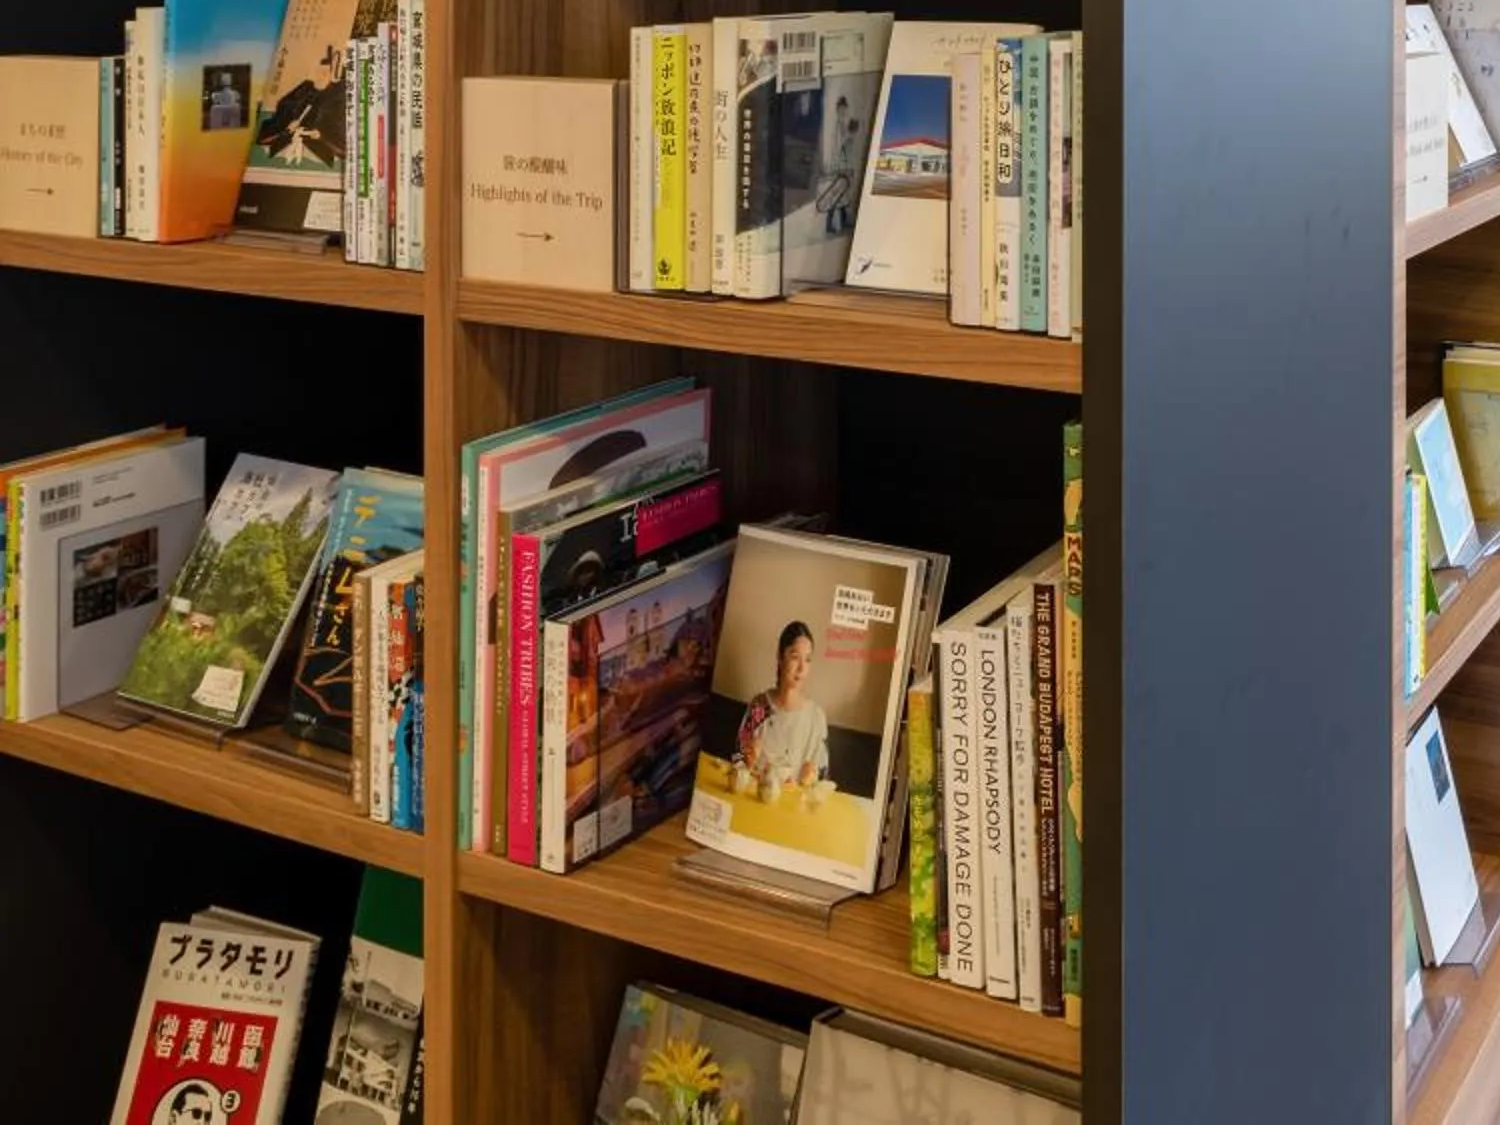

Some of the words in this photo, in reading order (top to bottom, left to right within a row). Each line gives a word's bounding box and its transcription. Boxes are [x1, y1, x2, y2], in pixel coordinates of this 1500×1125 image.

[660, 36, 677, 156] ニッポン放浪記
[717, 90, 729, 160] 街の人生
[998, 59, 1011, 178] ひとり旅日和
[471, 182, 532, 204] Highlights
[535, 189, 548, 205] of
[552, 190, 573, 207] the
[576, 191, 604, 212] Trip
[519, 550, 536, 631] FASHION
[1067, 535, 1082, 595] MAPS
[1036, 592, 1050, 621] THE
[518, 636, 534, 706] TRIBES
[1037, 625, 1051, 679] GRAND
[950, 641, 968, 726] SORRY
[980, 649, 998, 740] LONDON
[1038, 683, 1053, 762] BUDAPEST
[953, 734, 970, 783] FOR
[984, 745, 1001, 855] RHAPSODY
[1040, 767, 1054, 814] HOTEL
[954, 791, 973, 898] DAMAGE
[169, 934, 294, 980] ブラタモリ
[956, 904, 973, 973] DONE
[161, 968, 287, 993] BURATAMORI
[154, 1013, 181, 1060] 仙台
[177, 1018, 208, 1068] 奈良
[209, 1020, 235, 1066] 川越
[226, 1094, 235, 1109] 3
